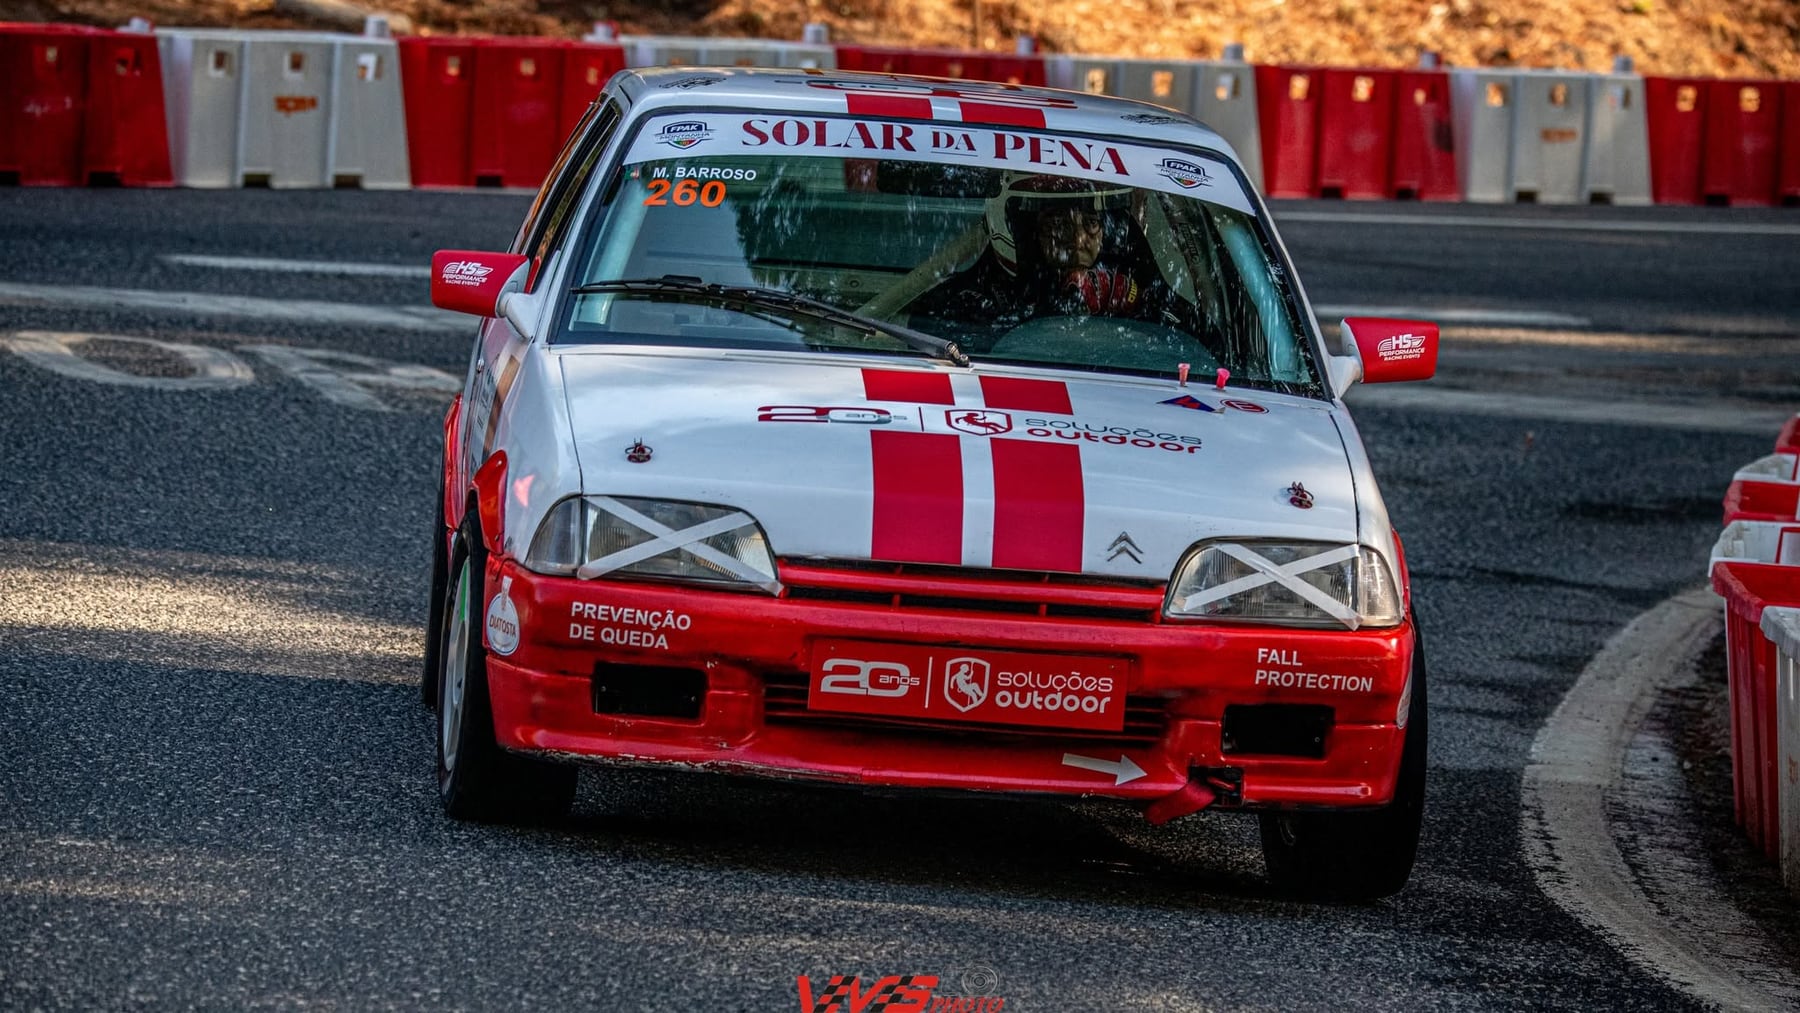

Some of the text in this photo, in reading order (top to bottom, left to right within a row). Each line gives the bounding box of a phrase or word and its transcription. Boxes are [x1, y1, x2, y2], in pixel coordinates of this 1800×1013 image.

[670, 124, 699, 133] FPAK
[741, 119, 1130, 176] SOLAR DA PENA
[652, 166, 757, 180] M. BARROSO
[1169, 161, 1197, 173] FPAK
[642, 179, 727, 208] 260
[443, 273, 488, 283] PERFORMANCE
[1379, 347, 1425, 357] PERFORMANCE
[757, 405, 892, 424] 20
[1025, 418, 1202, 445] soluções
[1027, 428, 1202, 454] outdoor
[489, 614, 517, 638] DIATOSTA
[571, 601, 692, 630] PREVENÇÃO
[569, 623, 669, 650] DE QUEDA
[1257, 648, 1303, 666] FALL
[820, 658, 920, 697] 20 anos
[997, 671, 1113, 693] soluções
[1254, 669, 1373, 692] PROTECTION
[995, 690, 1111, 713] outdoor
